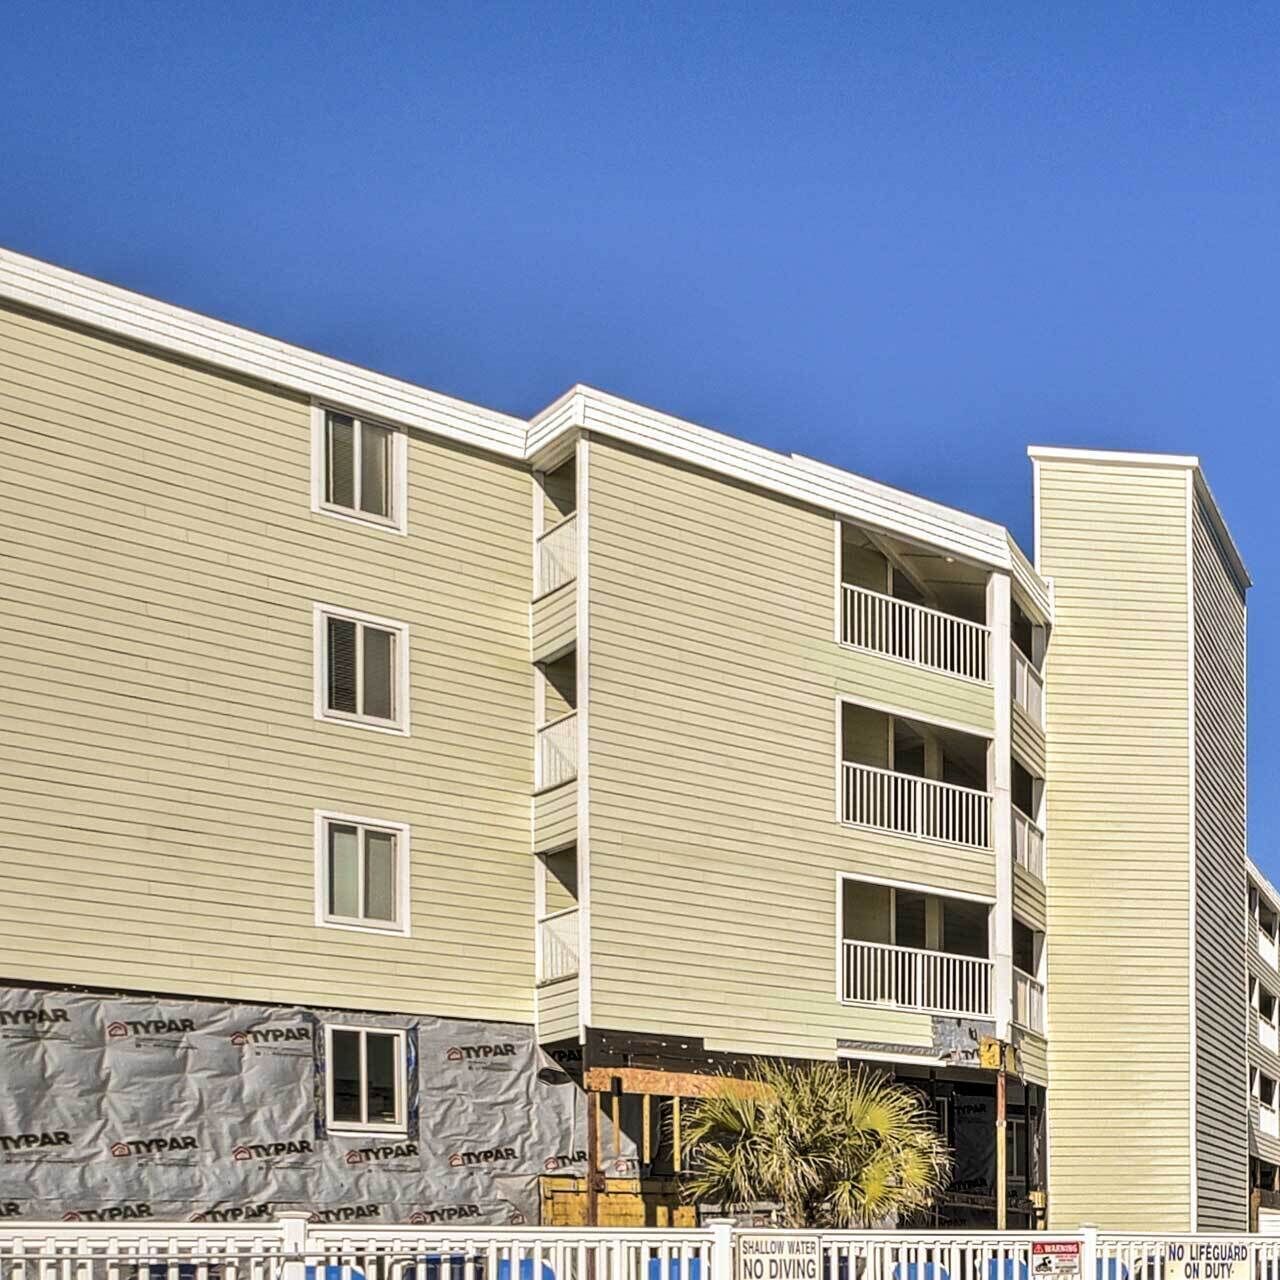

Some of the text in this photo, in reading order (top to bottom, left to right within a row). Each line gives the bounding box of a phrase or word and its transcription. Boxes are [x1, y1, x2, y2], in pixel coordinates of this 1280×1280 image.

[125, 1018, 195, 1035] TYPAR
[248, 1027, 311, 1043] TYPAR
[461, 1043, 516, 1059] TYPAR
[0, 1131, 72, 1150] TYPAR
[127, 1135, 198, 1154] TYPAR
[249, 1140, 313, 1158] TYPAR
[359, 1143, 419, 1161] TYPAR
[462, 1147, 518, 1165] TYPAR
[78, 1203, 153, 1222] TYPAR
[204, 1203, 274, 1223] TYPAR
[318, 1203, 381, 1222] TYPAR
[425, 1204, 482, 1223] TYPAR
[742, 1240, 816, 1255] SHALLOW WATER
[1168, 1244, 1248, 1261] NO LIFEGUARD
[743, 1258, 816, 1279] NO DIVING
[1184, 1262, 1232, 1279] ON DUTY
